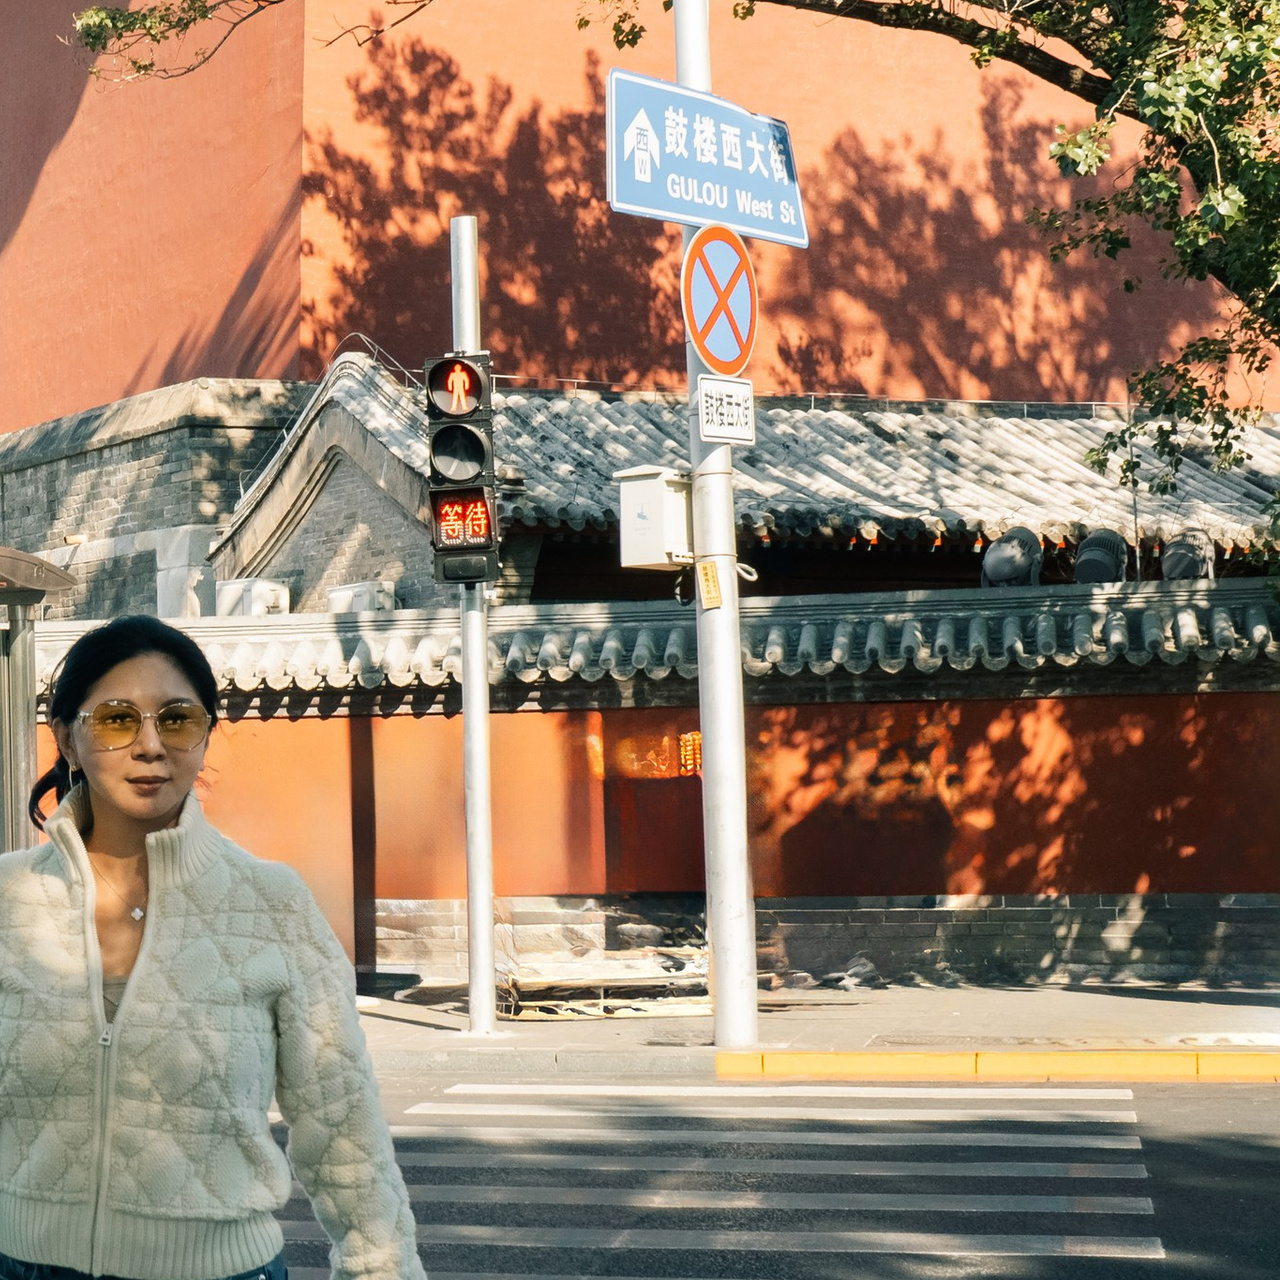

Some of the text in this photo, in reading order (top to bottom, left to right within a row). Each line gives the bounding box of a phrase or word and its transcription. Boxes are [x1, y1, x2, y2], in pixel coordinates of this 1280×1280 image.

[635, 126, 649, 153] 西
[664, 105, 790, 187] 鼓楼西大街
[637, 158, 647, 176] W
[666, 173, 797, 226] GULOU West St
[441, 501, 487, 537] 等待
